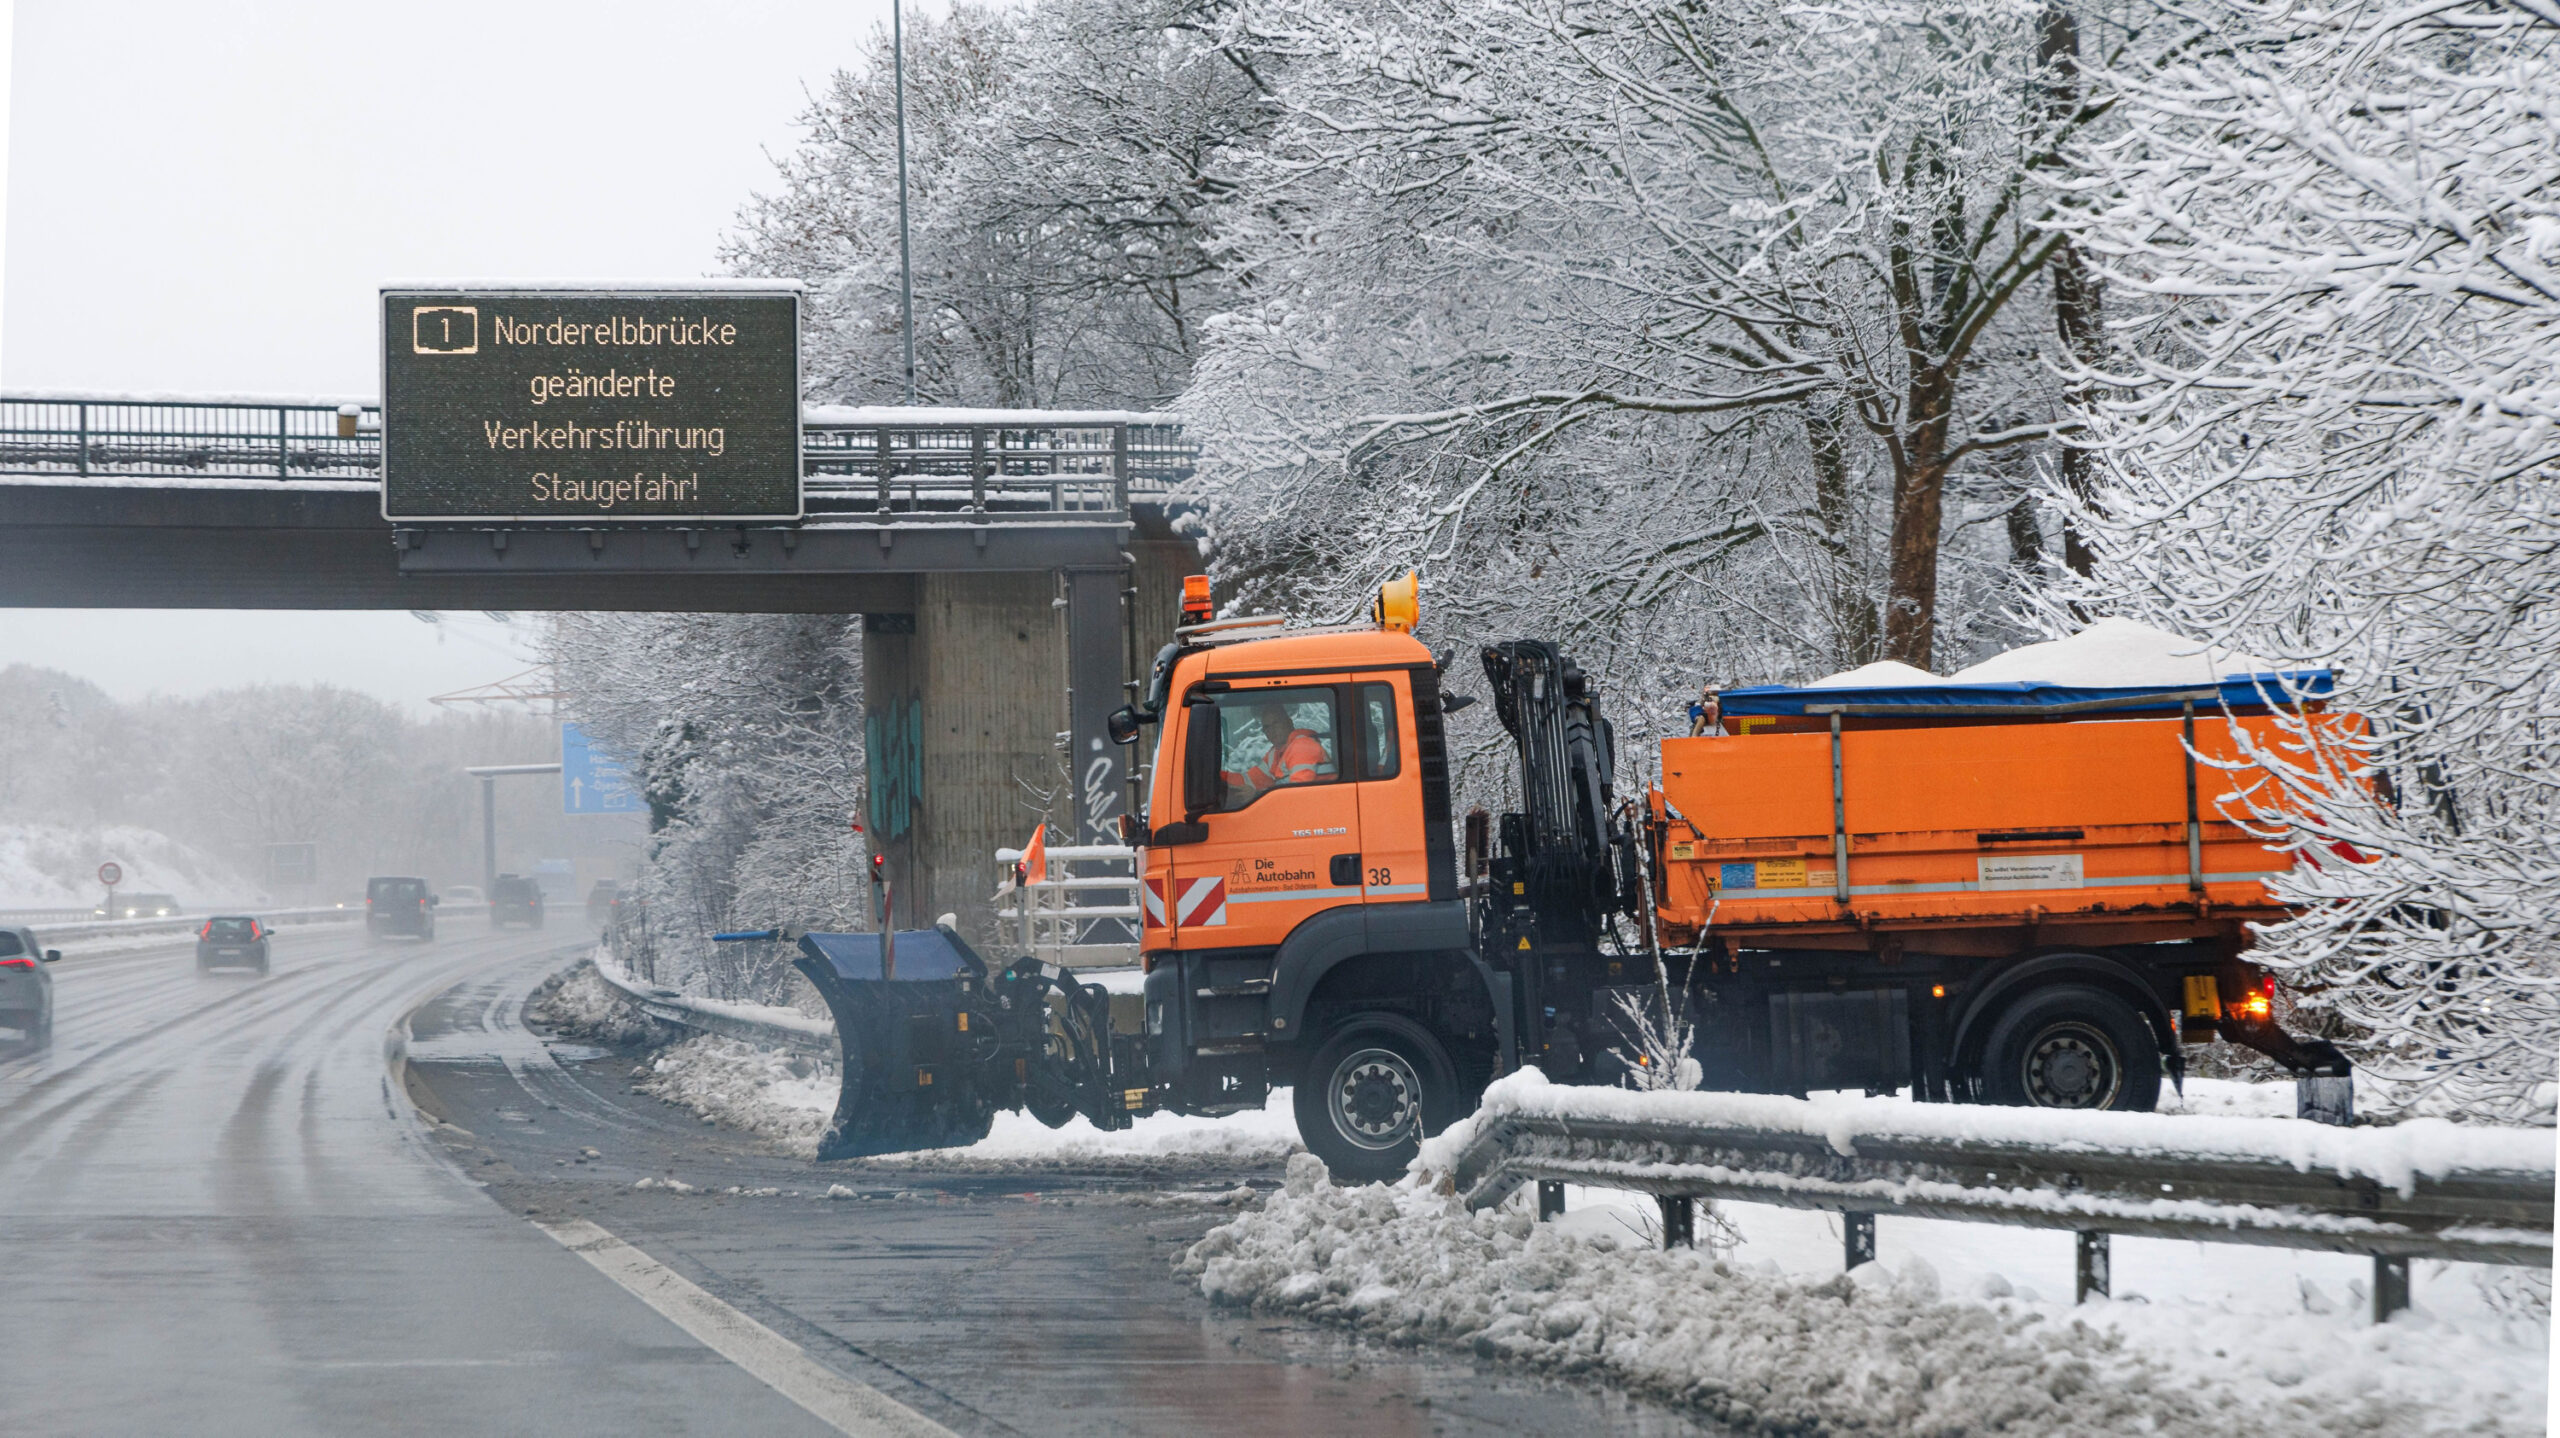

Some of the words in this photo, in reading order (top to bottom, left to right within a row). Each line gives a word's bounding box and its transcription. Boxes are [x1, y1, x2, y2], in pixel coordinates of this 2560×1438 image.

[440, 317, 449, 343] 1
[495, 315, 737, 346] Norderelbbrücke
[530, 368, 676, 405] geänderte
[484, 420, 725, 456] Verkehrsführung
[531, 472, 699, 508] Staugefahr!
[1292, 829, 1312, 837] TGS
[1313, 826, 1347, 836] 18.320
[1255, 859, 1275, 870] Die
[1256, 869, 1316, 882] Autobahn
[1368, 867, 1392, 886] 38
